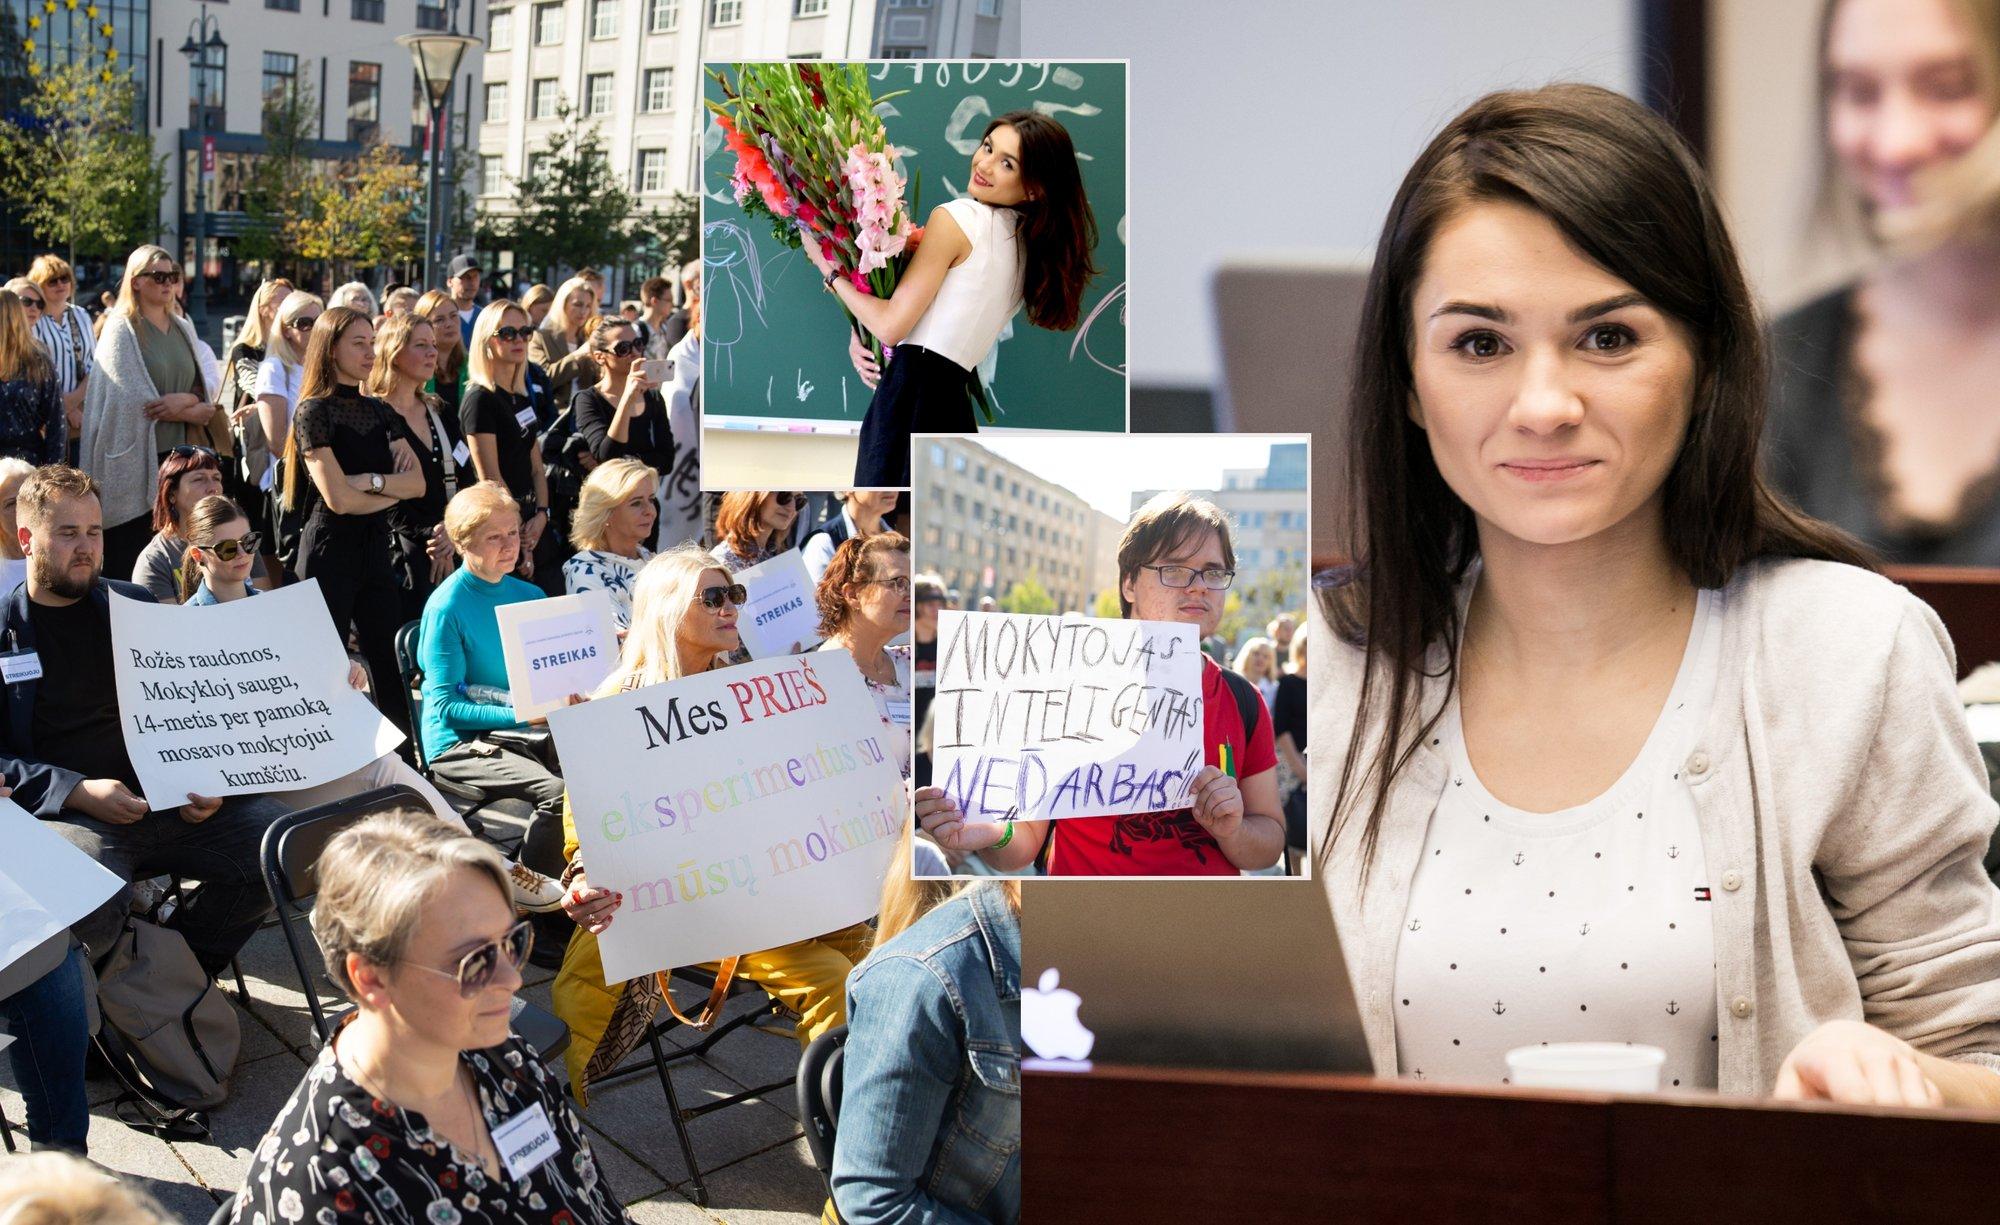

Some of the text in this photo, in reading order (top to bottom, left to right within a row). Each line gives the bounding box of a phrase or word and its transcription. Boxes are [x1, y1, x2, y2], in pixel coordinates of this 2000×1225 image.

[755, 596, 803, 626] STREIKAS
[130, 647, 281, 669] Rožės raudonos,
[532, 646, 597, 670] STREIKAS
[140, 675, 299, 704] Mokykloj saugu,
[635, 656, 828, 750] Mes PRIEŠ
[133, 698, 332, 734] 14-metis per pamoką
[158, 725, 334, 763] mosavo mokytojui
[220, 764, 307, 787] kumščiu.
[601, 736, 885, 842] eksperimentus su
[628, 855, 760, 912] mūsų
